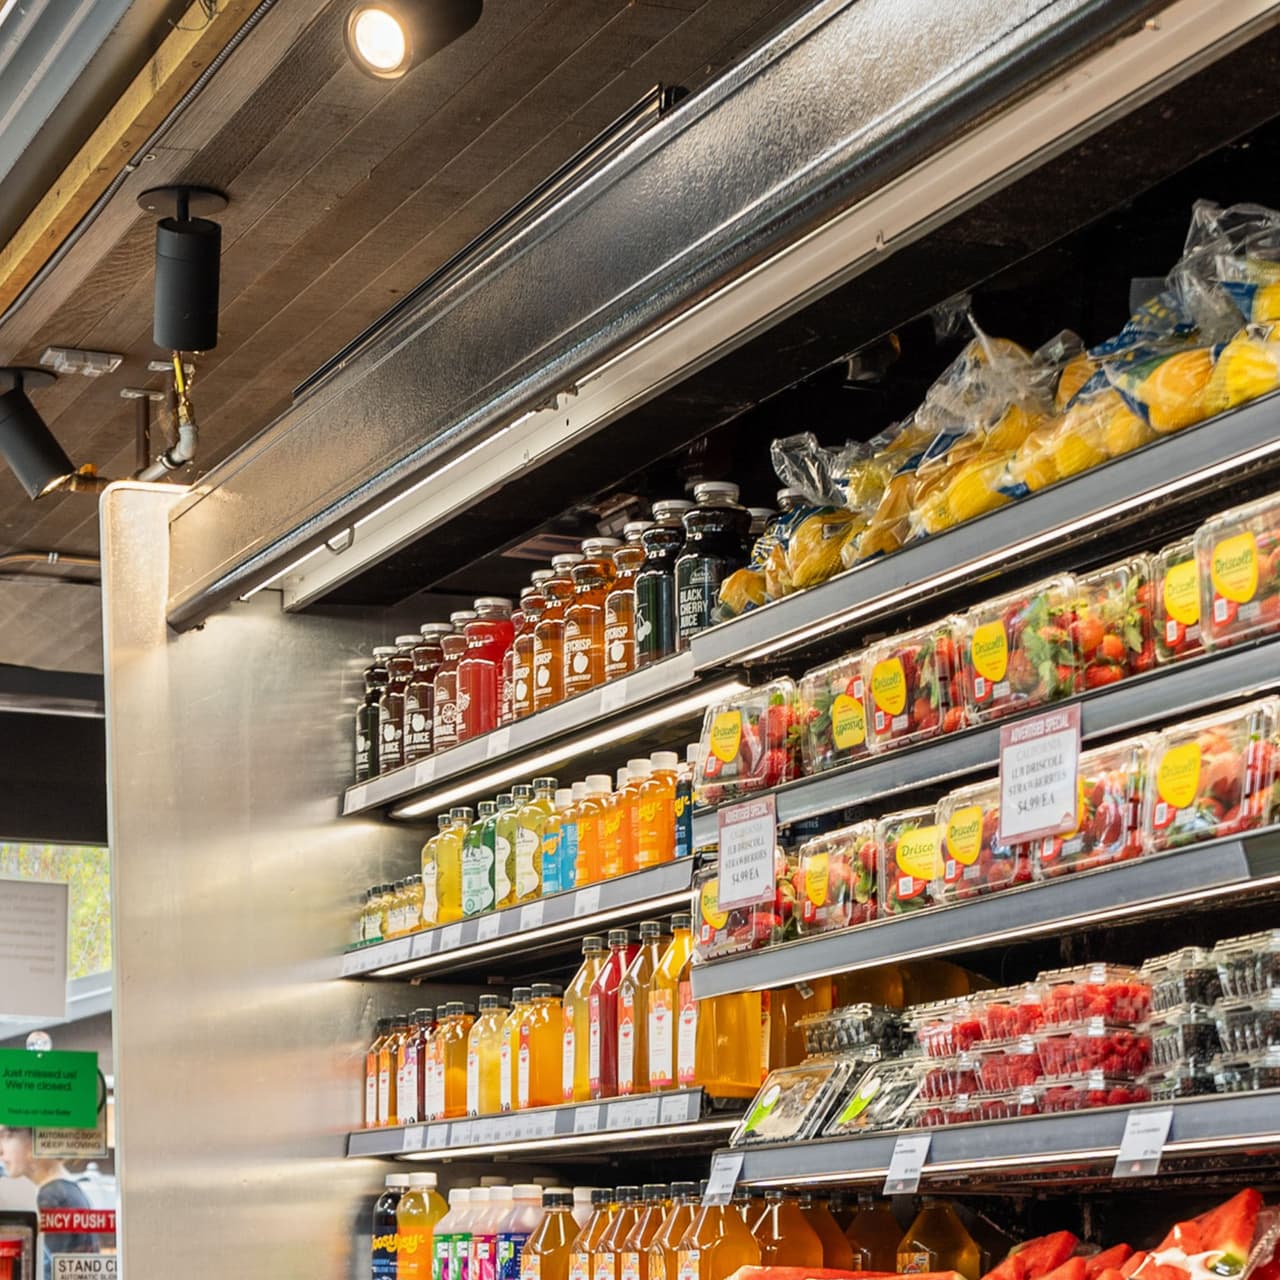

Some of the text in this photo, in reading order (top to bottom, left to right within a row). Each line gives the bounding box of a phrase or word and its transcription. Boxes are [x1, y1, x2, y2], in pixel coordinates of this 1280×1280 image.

[680, 588, 703, 602] BLACK
[680, 601, 709, 614] CHERRY
[680, 613, 698, 627] JUICE
[1008, 769, 1067, 796] STRAWBERRIES
[901, 841, 935, 858] Drisco
[4, 1079, 36, 1091] We're
[40, 1141, 102, 1150] KEEP MOVING
[73, 1214, 104, 1229] PUSH
[58, 1260, 102, 1273] STAND
